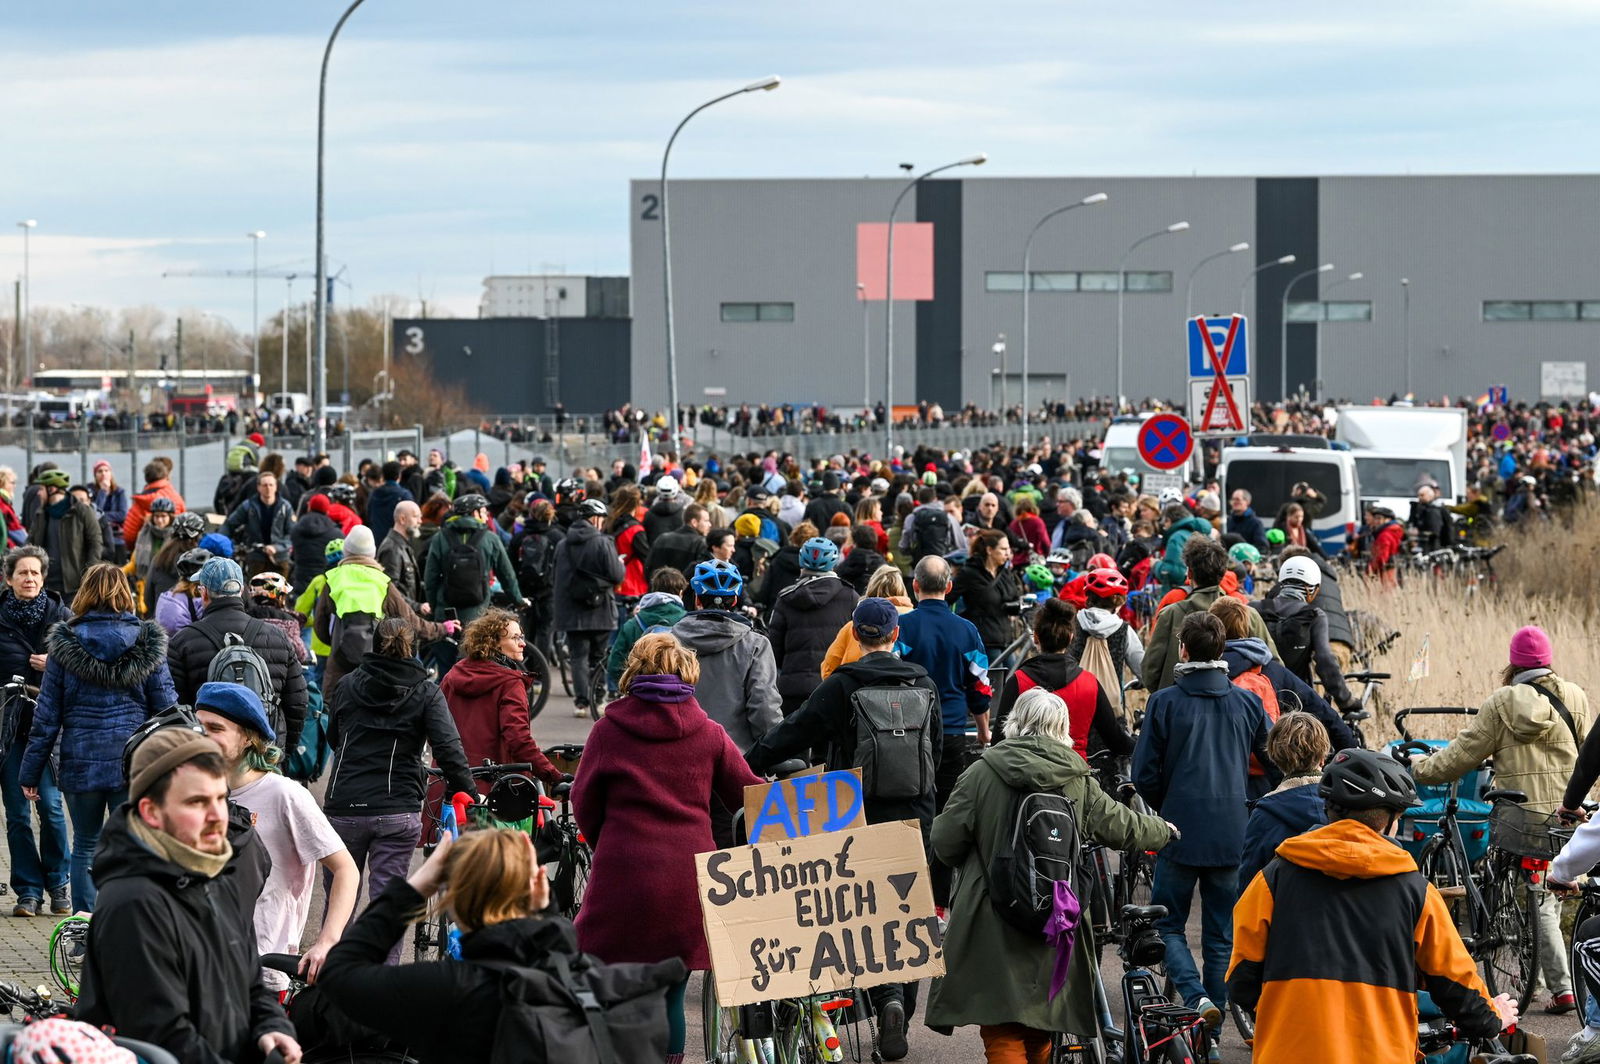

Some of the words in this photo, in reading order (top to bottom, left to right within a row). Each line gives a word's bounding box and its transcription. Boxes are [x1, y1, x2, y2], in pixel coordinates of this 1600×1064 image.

[641, 194, 659, 221] 2
[405, 327, 424, 354] 3
[748, 770, 863, 844] AFD
[795, 880, 876, 927] EUCH
[750, 937, 801, 991] für
[809, 916, 943, 980] ALLES!
